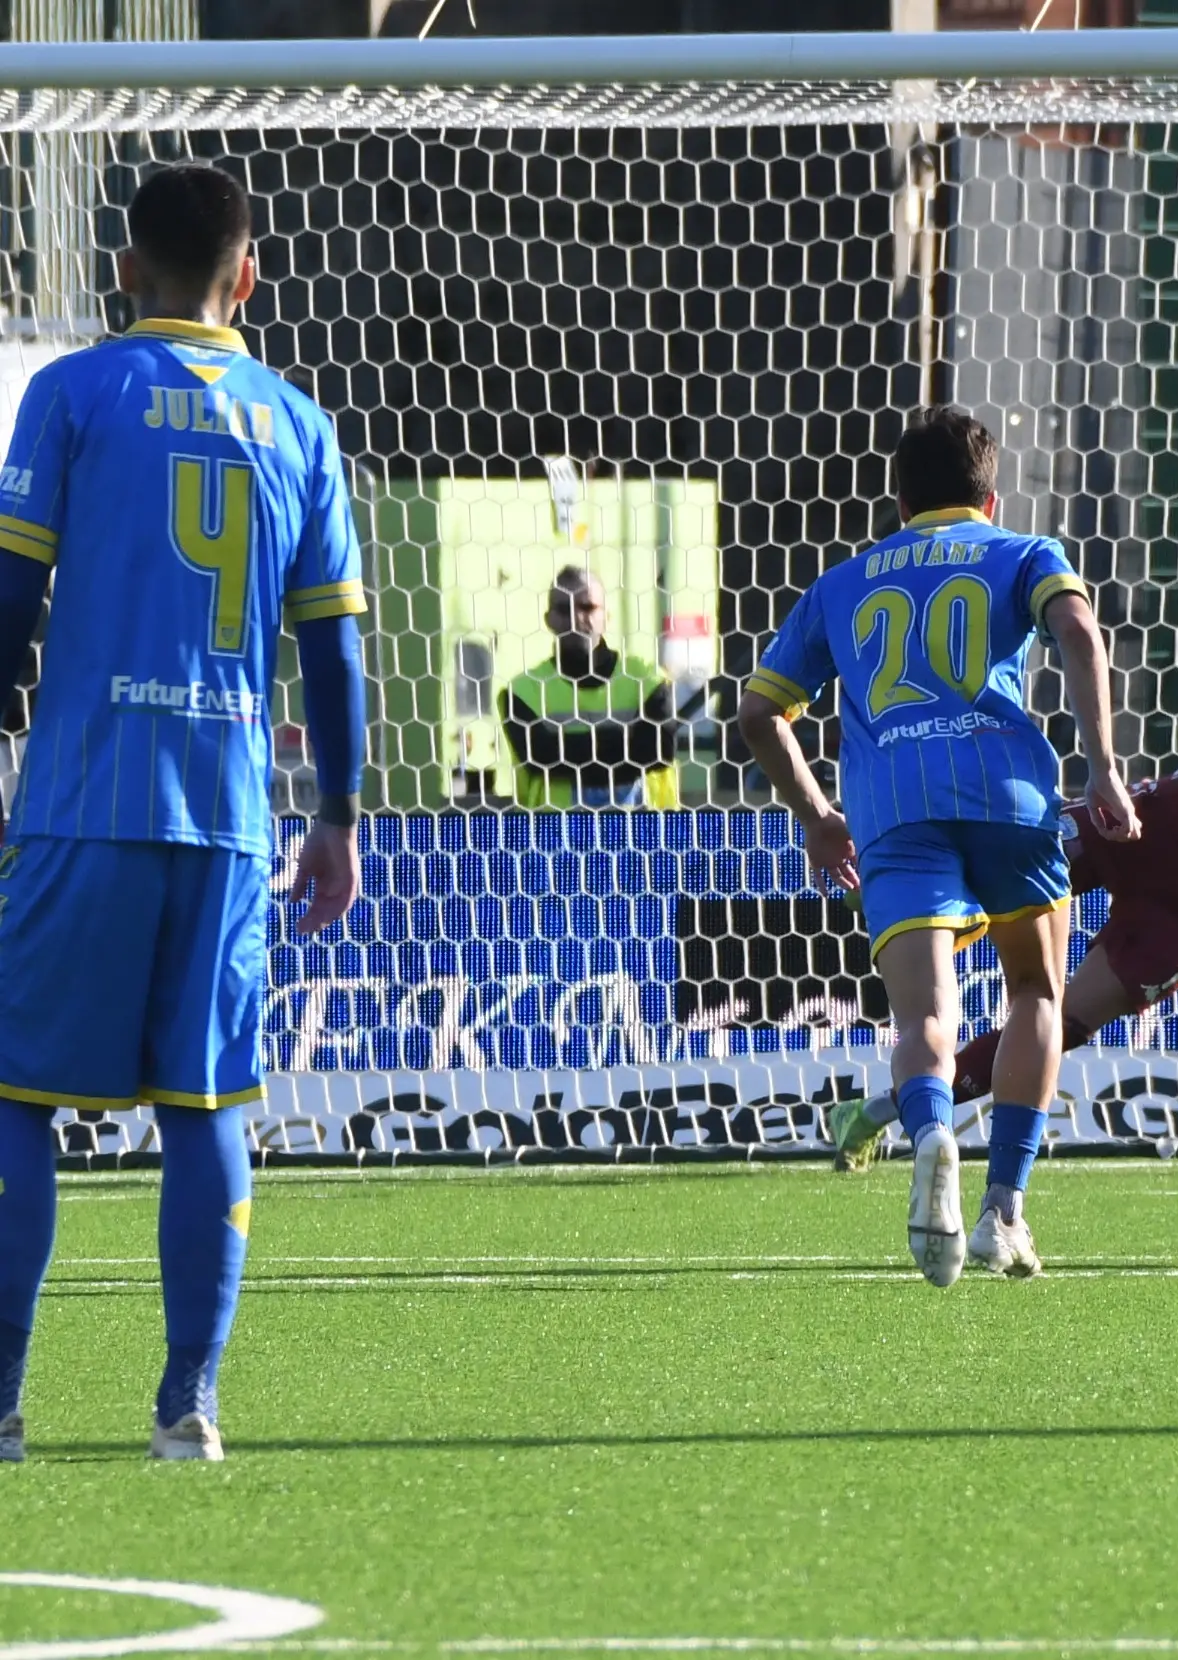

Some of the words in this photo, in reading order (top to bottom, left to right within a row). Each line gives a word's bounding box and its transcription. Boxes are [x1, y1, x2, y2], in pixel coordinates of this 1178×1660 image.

[168, 453, 260, 658] 4
[865, 540, 989, 579] GIOVANE
[852, 573, 992, 724] 20
[341, 1073, 870, 1152] GoldBet
